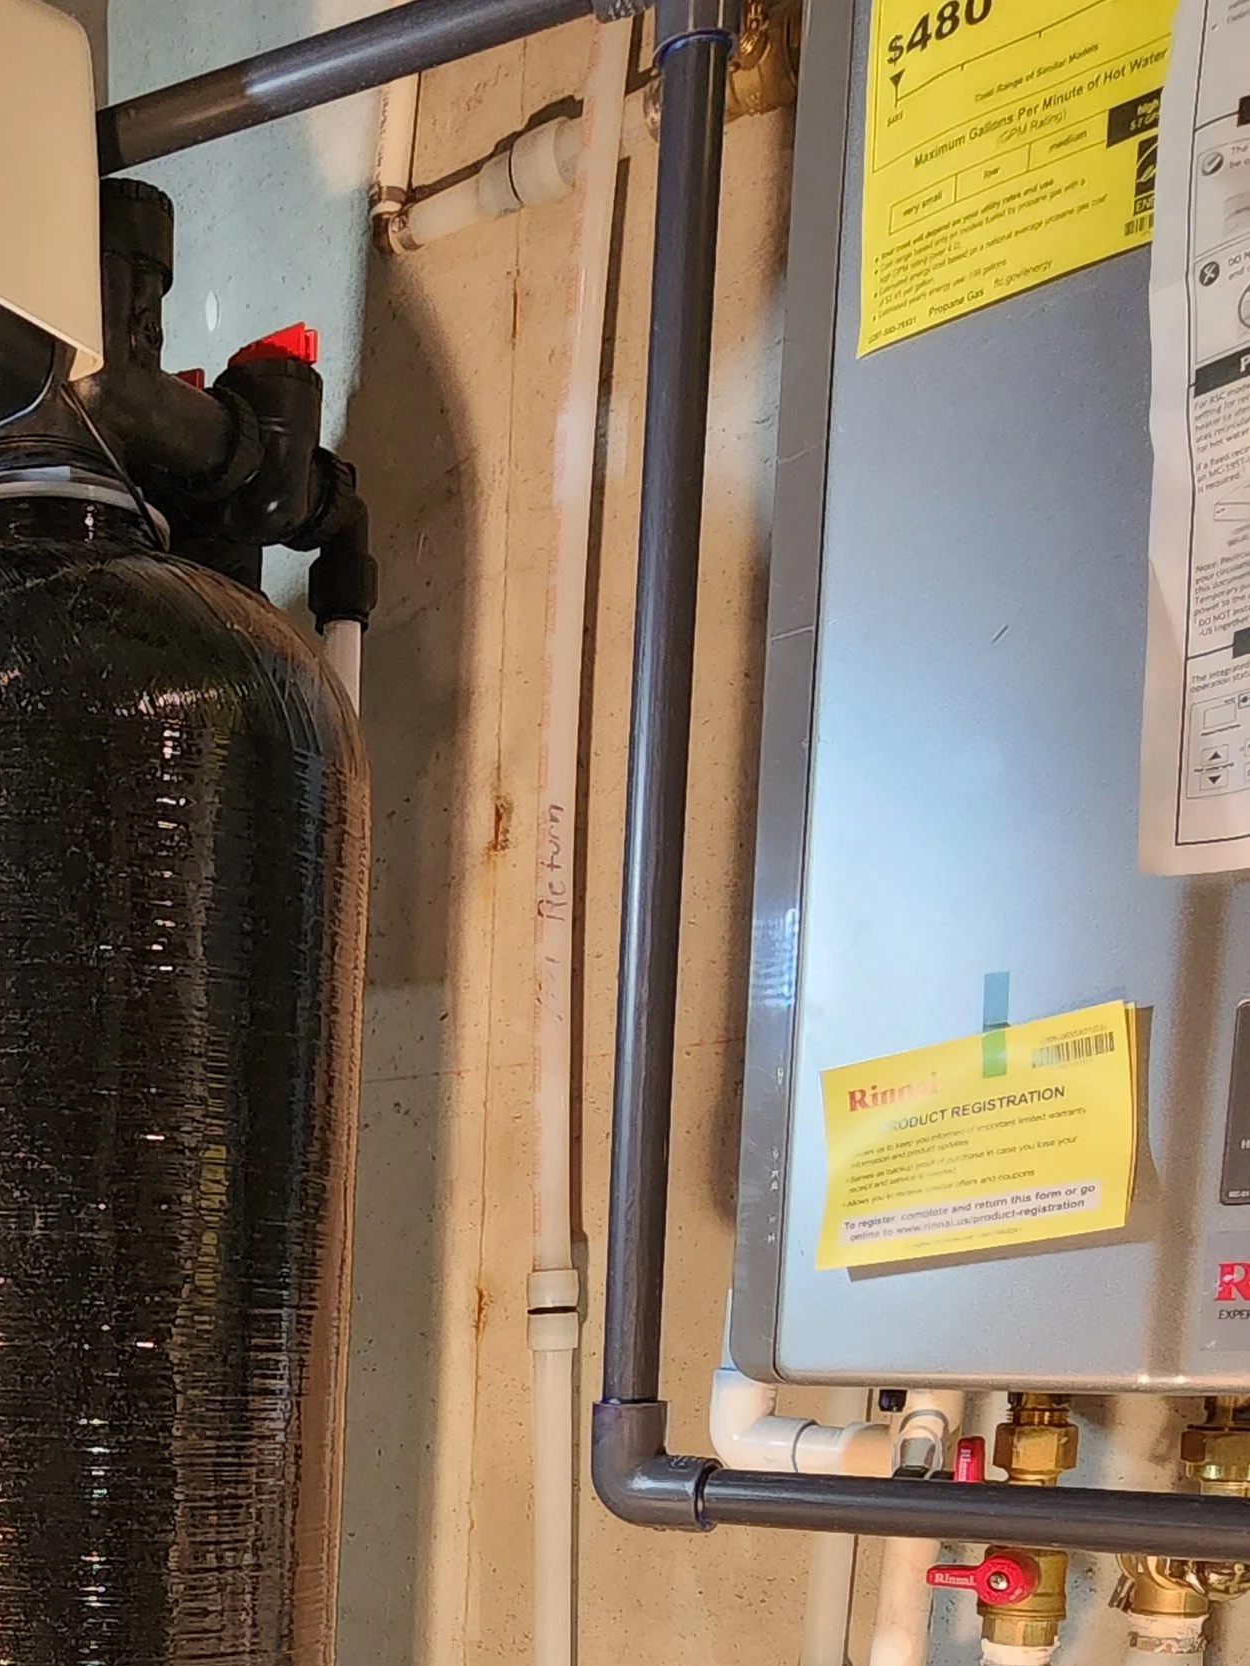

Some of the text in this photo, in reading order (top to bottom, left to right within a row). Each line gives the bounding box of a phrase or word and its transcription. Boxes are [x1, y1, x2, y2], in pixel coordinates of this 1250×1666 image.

[887, 0, 992, 66] $480
[996, 76, 1023, 94] Range
[1025, 71, 1035, 82] of
[914, 48, 1169, 168] Maximum Gallons Per Minute of Hot Water
[1049, 131, 1087, 153] medium
[928, 296, 965, 318] Propane
[966, 288, 985, 303] Gas
[884, 1086, 1065, 1134] RODUCT REGISTRATION
[996, 1145, 1017, 1156] case
[1019, 1143, 1035, 1153] you
[1058, 1136, 1079, 1148] your
[980, 1173, 996, 1184] and
[998, 1168, 1035, 1182] coupons
[844, 1220, 856, 1231] To
[901, 1206, 948, 1222] complete
[951, 1200, 971, 1214] and
[974, 1198, 1007, 1211] return
[1010, 1193, 1031, 1205] this
[1035, 1189, 1062, 1201] form
[1065, 1187, 1078, 1197] or
[1081, 1184, 1096, 1197] go
[850, 1198, 1085, 1242] online to www.rinnai.us/product-registration
[934, 1572, 977, 1586] Rinnai
